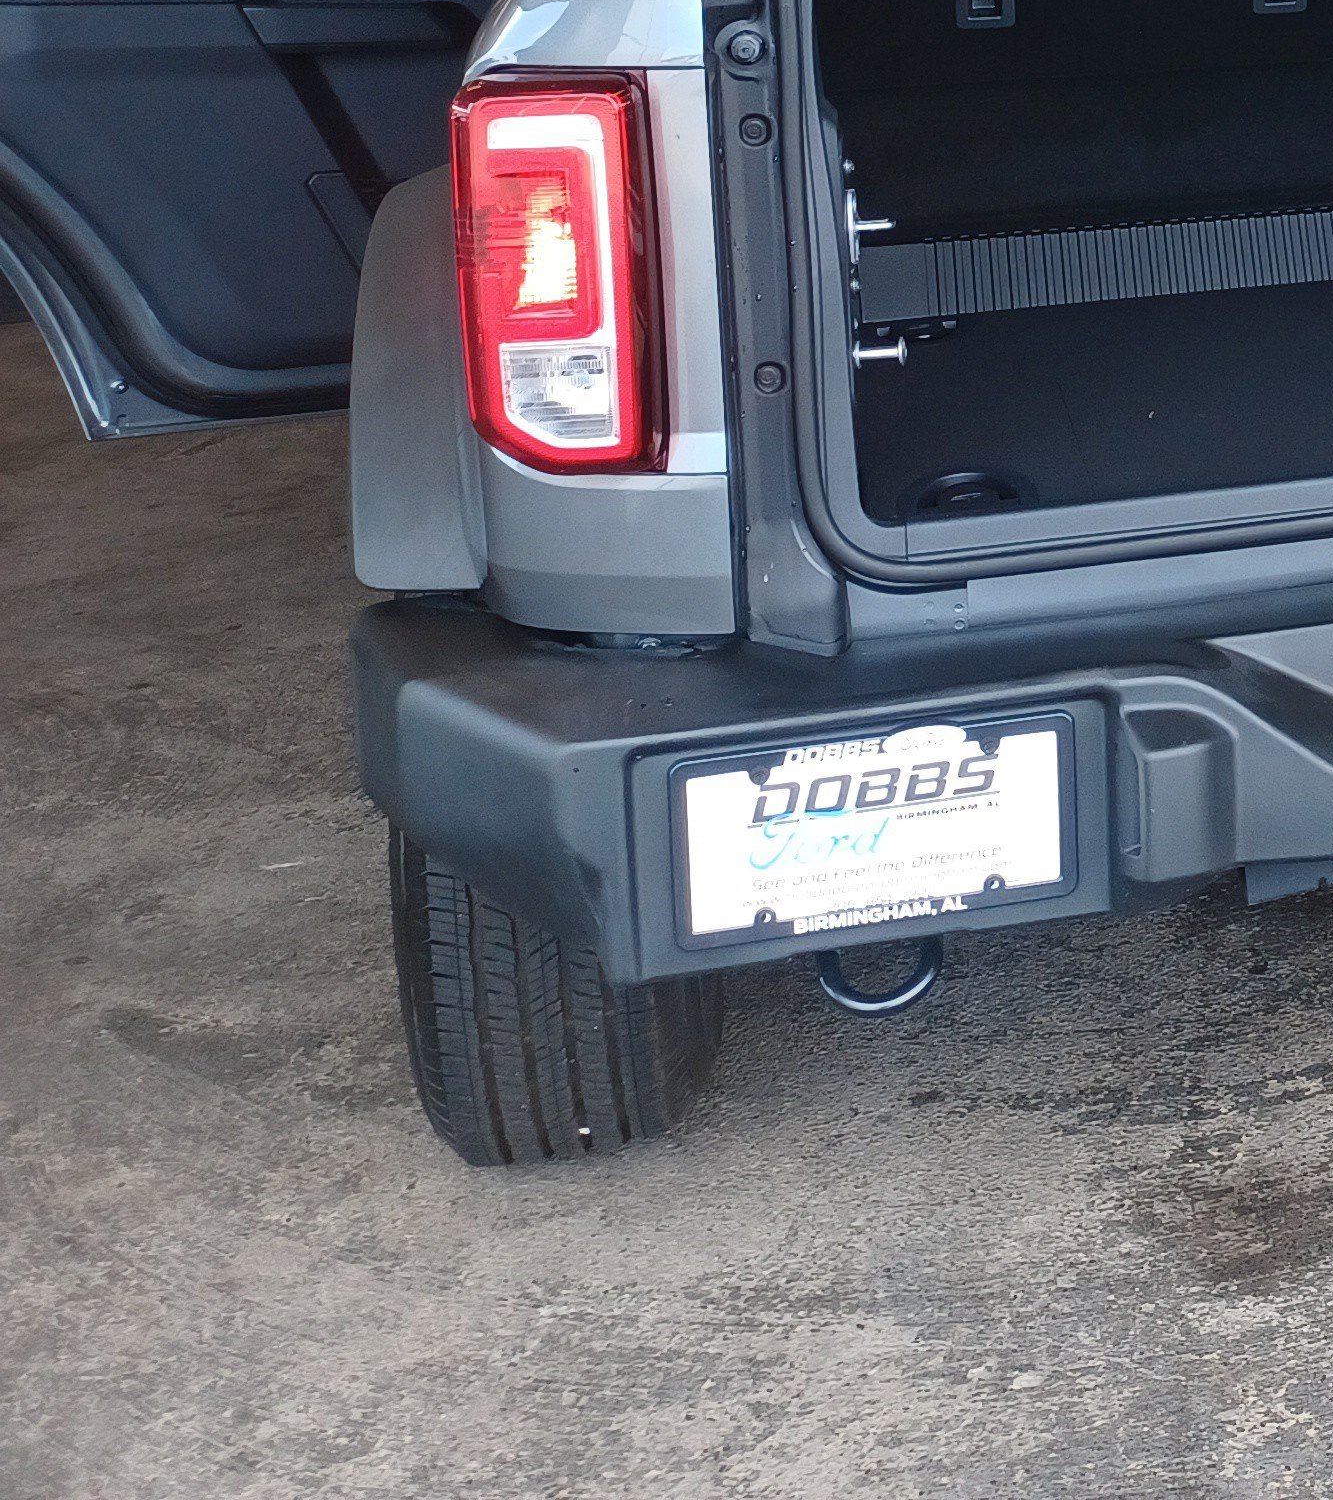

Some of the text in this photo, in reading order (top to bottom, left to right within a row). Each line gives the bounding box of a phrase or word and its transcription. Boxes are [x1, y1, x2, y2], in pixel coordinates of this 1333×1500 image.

[783, 738, 884, 766] DOBBS
[751, 753, 999, 824] DOBBS
[896, 803, 978, 820] BIRMINGHAM
[793, 901, 938, 935] BIRMINGHAM,
[940, 895, 969, 913] AL
